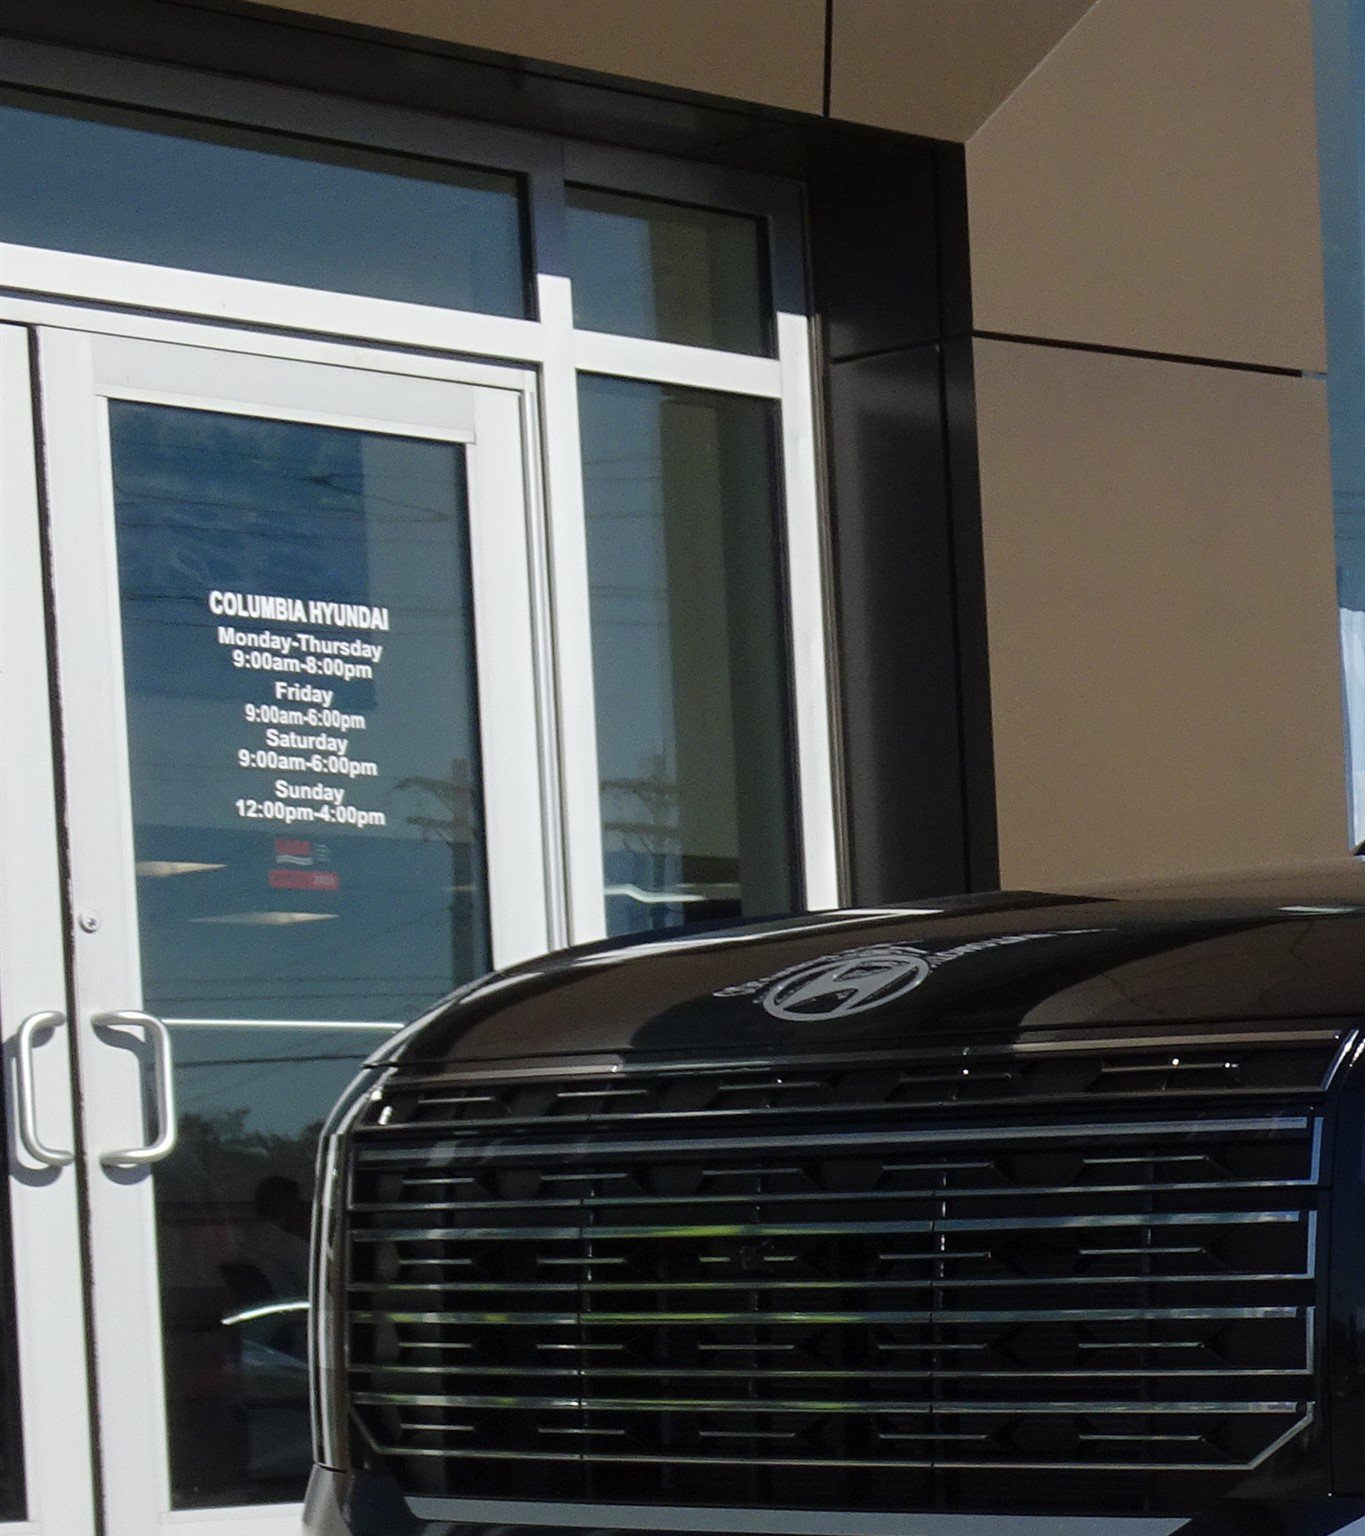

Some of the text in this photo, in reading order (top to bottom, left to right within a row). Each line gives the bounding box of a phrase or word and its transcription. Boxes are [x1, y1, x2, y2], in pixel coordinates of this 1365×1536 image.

[209, 591, 389, 630] COLUMBIA HYUNDAI
[217, 626, 382, 662] Monday-Thursday
[232, 650, 373, 680] 9:00am-8:00pm
[275, 682, 333, 707] Friday
[245, 704, 366, 729] 9:00am-6:00pm
[266, 729, 348, 755] Saturday
[238, 750, 378, 778] 9:00am-6:00pm
[275, 780, 344, 805] Sunday
[235, 799, 386, 828] 12:00pm-4:00pm
